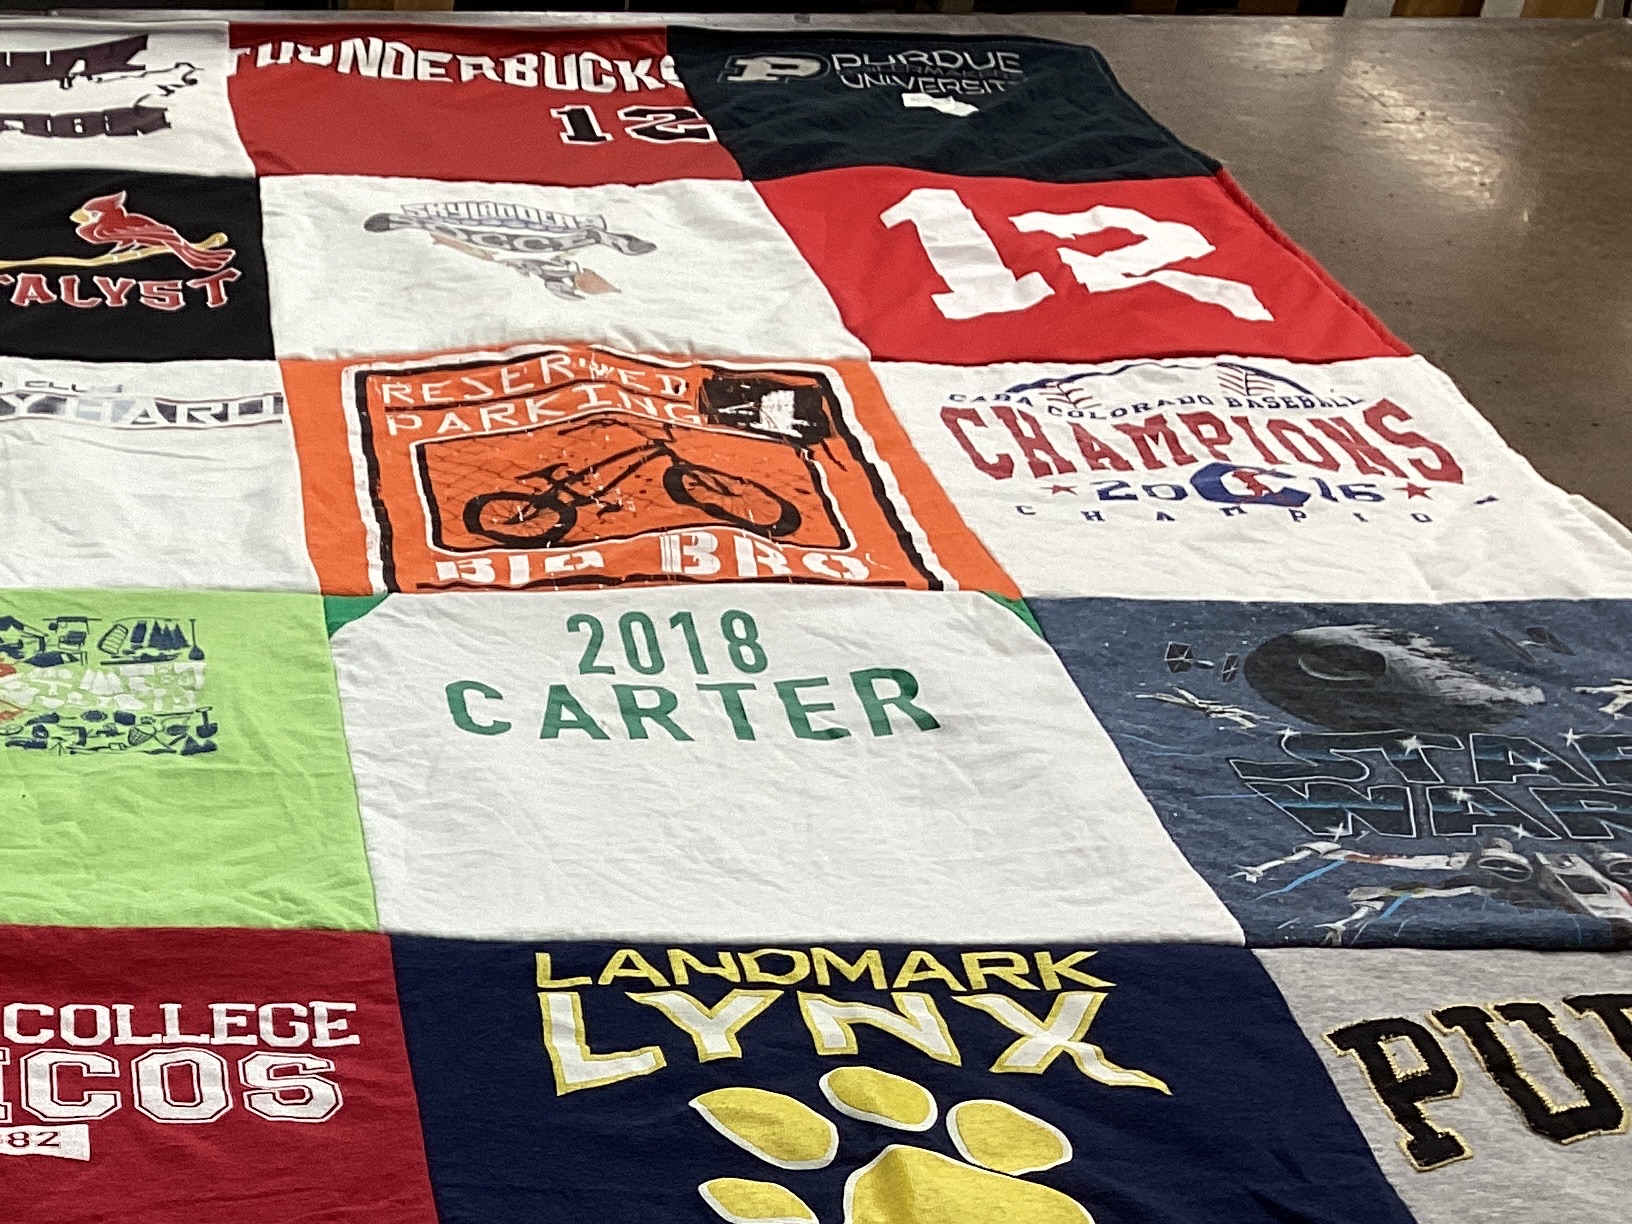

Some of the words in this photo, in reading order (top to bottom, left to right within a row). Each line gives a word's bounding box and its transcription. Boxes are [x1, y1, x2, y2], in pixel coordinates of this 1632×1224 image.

[831, 50, 1023, 74] PURDUE
[550, 104, 718, 145] 12
[880, 188, 1275, 321] 12
[385, 382, 708, 435] PARKING
[1046, 394, 1215, 421] COLORADO
[1225, 394, 1364, 411] BASEBALL
[939, 397, 1464, 485] CHAMPIONS
[565, 608, 769, 676] 2018
[444, 667, 943, 742] CARTER
[536, 948, 1116, 991] LANDMARK
[3, 1001, 360, 1048] COLLEGE
[539, 988, 1173, 1096] LYNX
